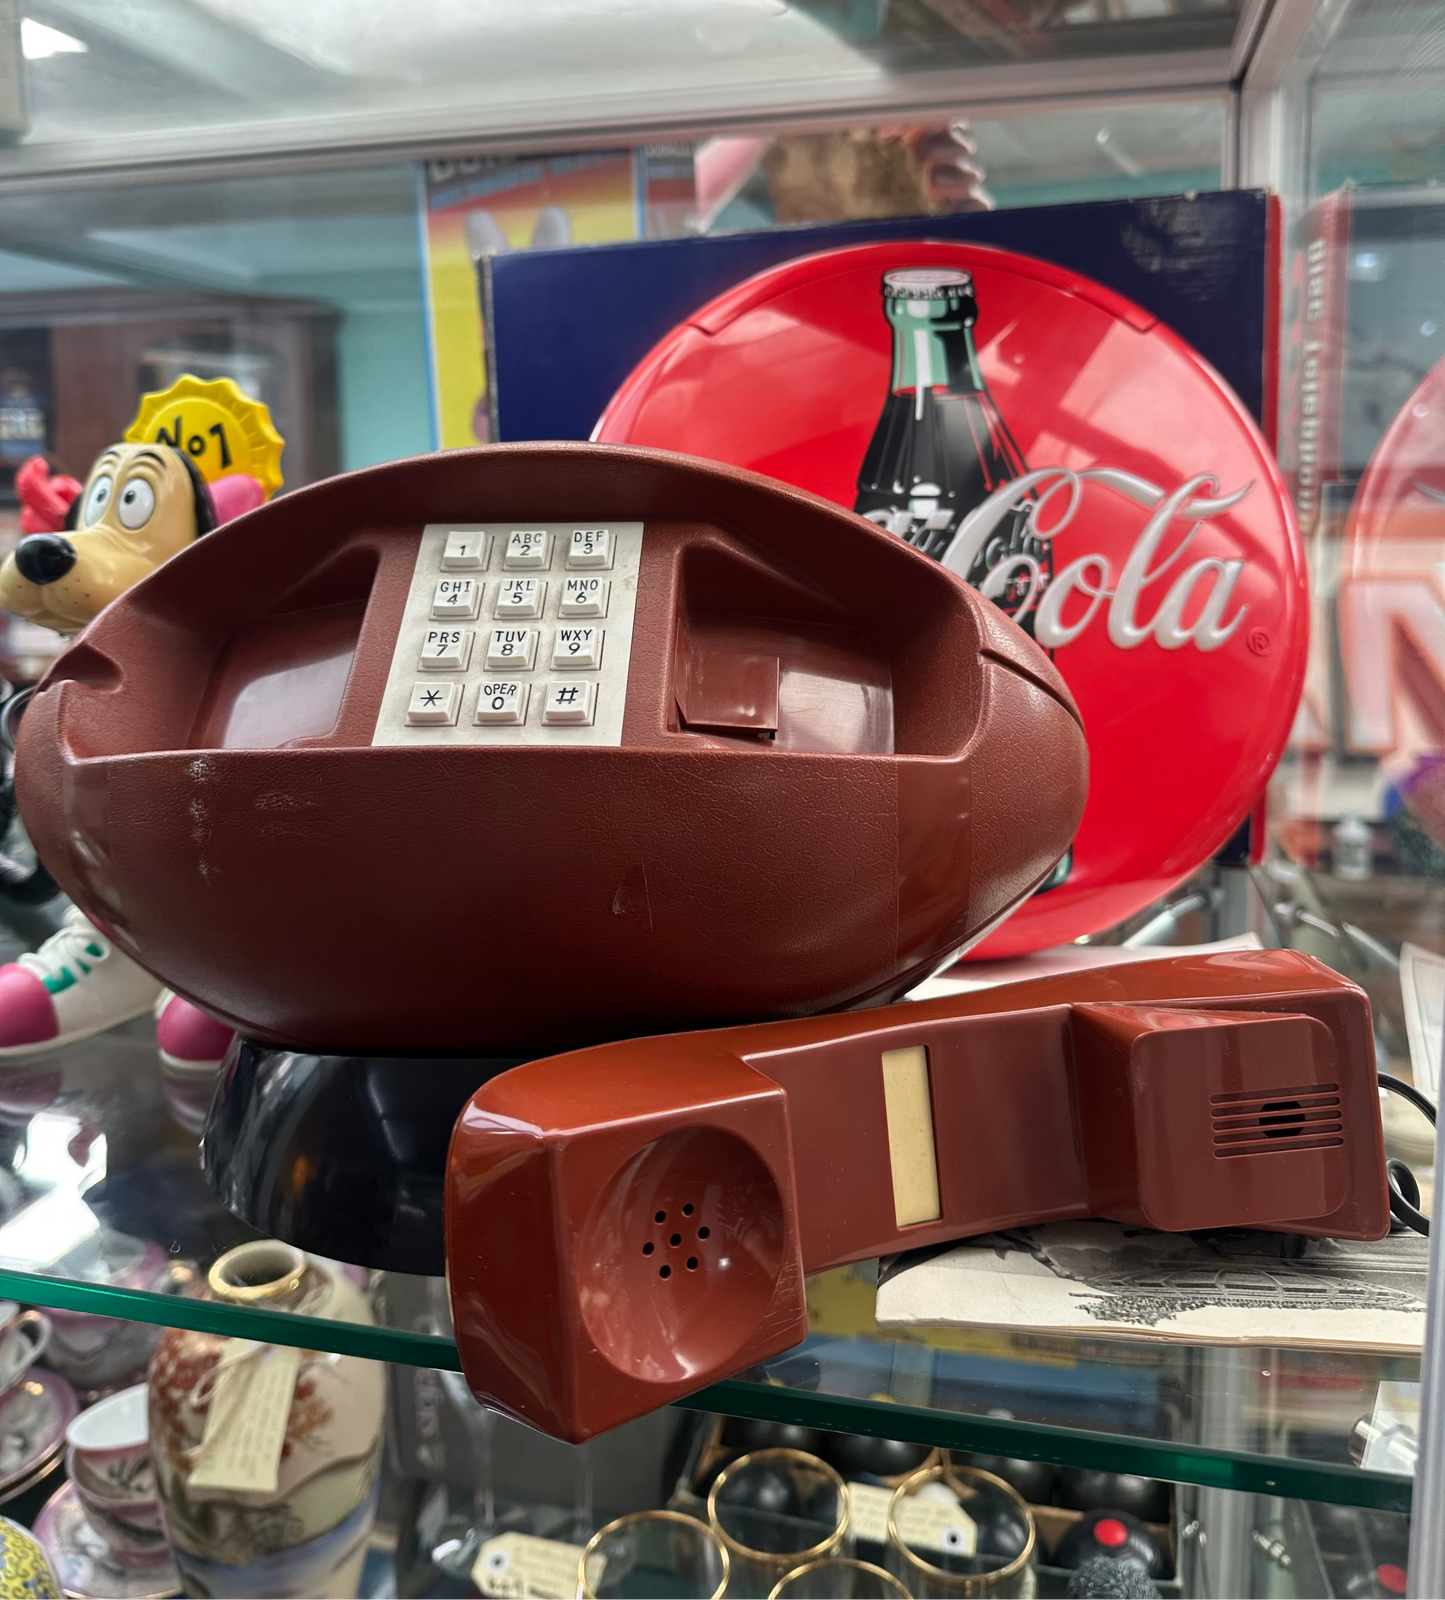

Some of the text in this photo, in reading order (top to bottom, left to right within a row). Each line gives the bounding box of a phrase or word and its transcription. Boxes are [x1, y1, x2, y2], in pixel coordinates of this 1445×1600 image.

[511, 533, 543, 544] ABC
[573, 531, 605, 542] DEF
[459, 545, 467, 556] 1
[519, 545, 531, 556] 2
[582, 543, 594, 555] 3
[439, 581, 472, 593] GHI
[503, 580, 534, 592] JKL
[567, 579, 599, 591] MNO
[446, 593, 459, 605] 4
[511, 592, 523, 604] 5
[575, 592, 588, 604] 6
[428, 631, 461, 644] PRS
[495, 630, 527, 643] TUV
[560, 629, 593, 641] WXY
[436, 644, 449, 657] 7
[500, 643, 514, 656] 8
[568, 642, 581, 655] 9
[484, 683, 517, 697] OPER
